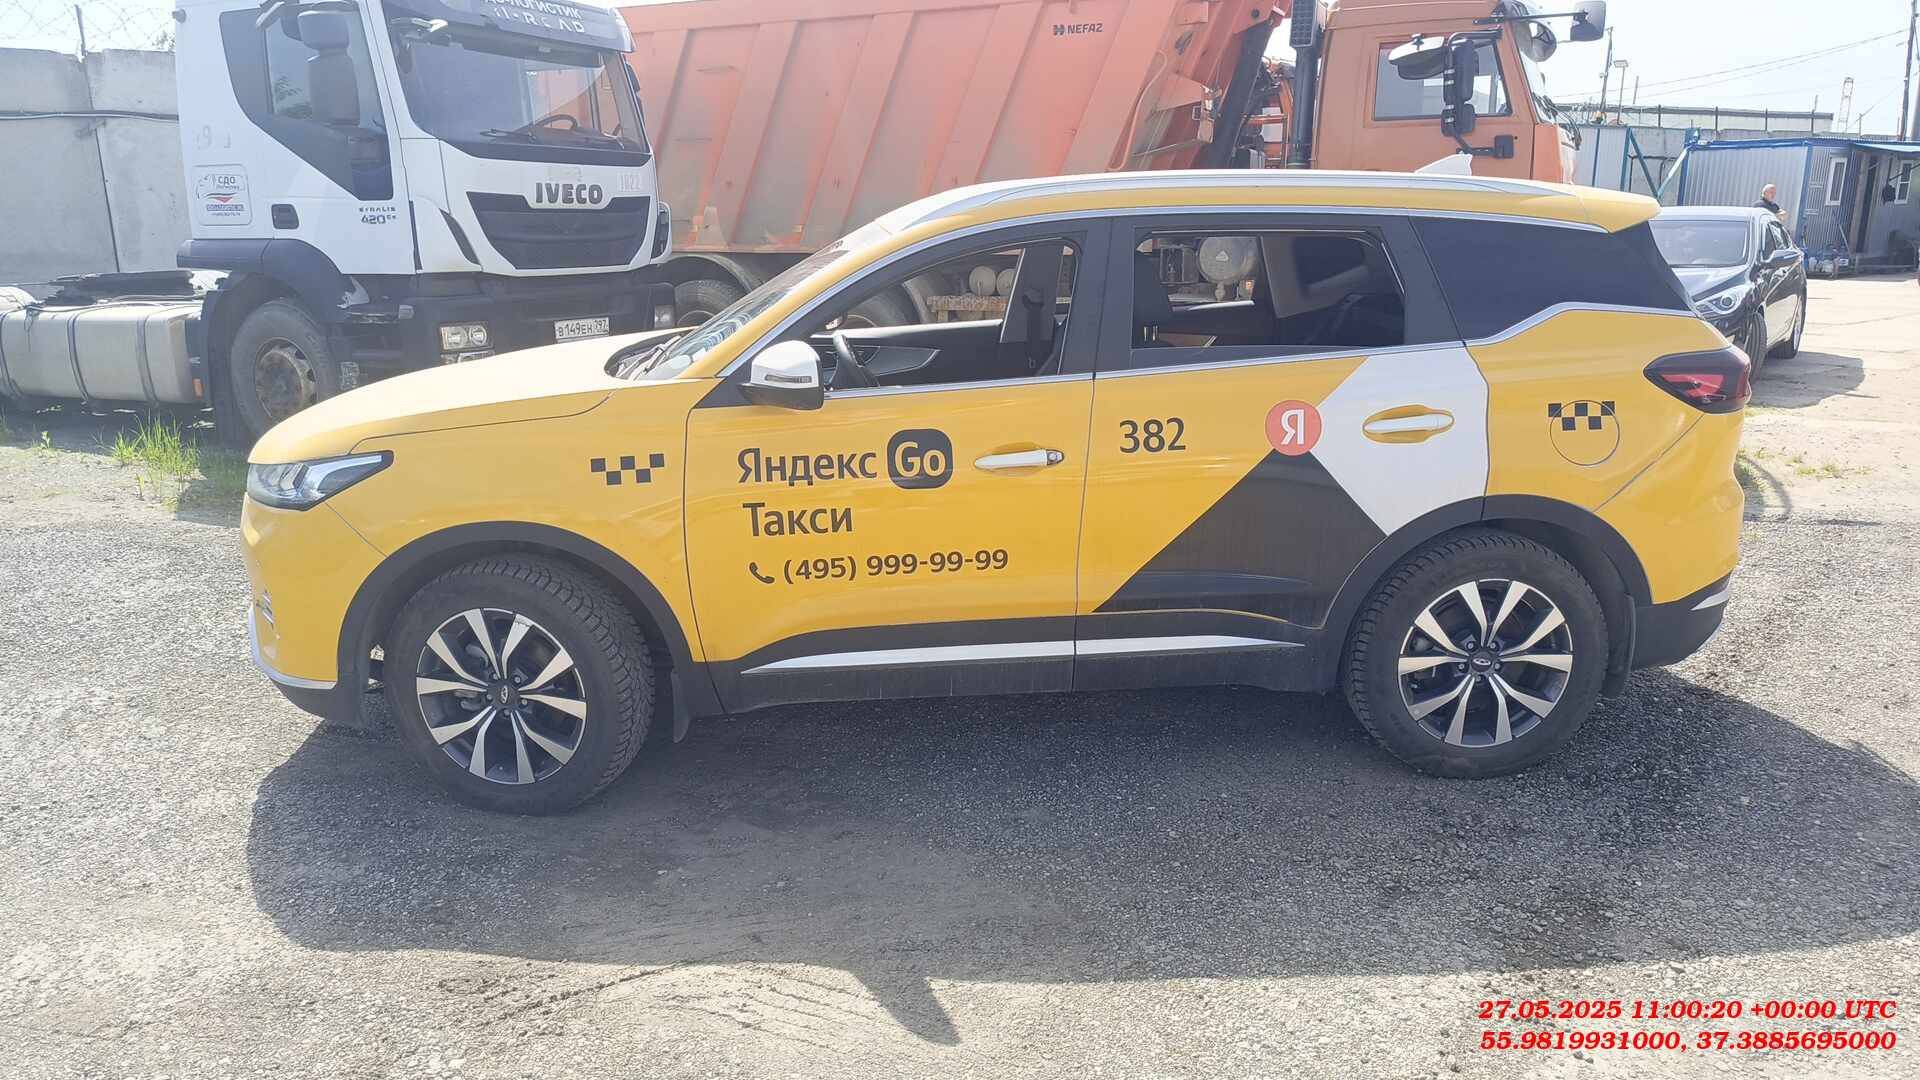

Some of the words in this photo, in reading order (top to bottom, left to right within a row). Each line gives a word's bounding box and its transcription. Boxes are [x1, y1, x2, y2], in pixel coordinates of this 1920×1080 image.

[1067, 23, 1103, 34] NEFAZ
[536, 182, 603, 205] IVECO
[1119, 417, 1186, 453] 382
[1280, 408, 1305, 446] Я
[737, 447, 878, 486] Яндекс
[894, 441, 947, 478] Go
[742, 501, 853, 537] Такси
[784, 556, 857, 584] (495)
[866, 549, 1008, 576] 999-99-99
